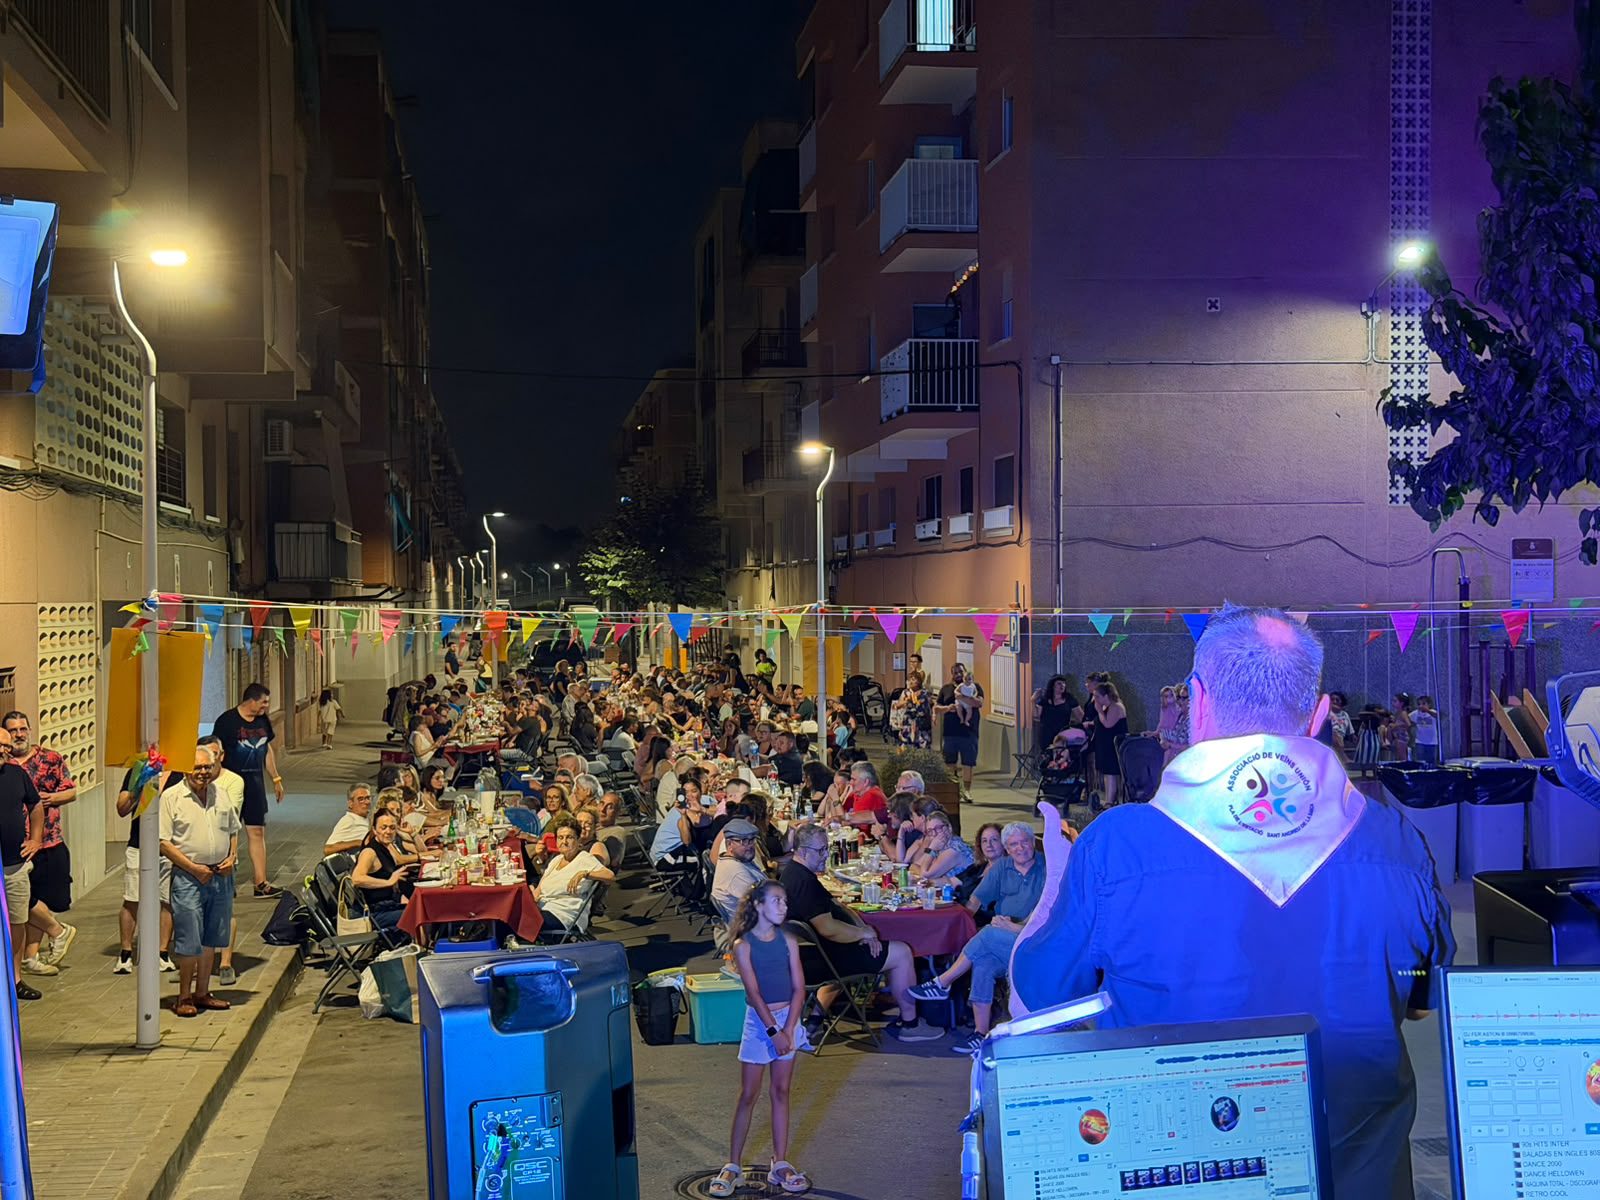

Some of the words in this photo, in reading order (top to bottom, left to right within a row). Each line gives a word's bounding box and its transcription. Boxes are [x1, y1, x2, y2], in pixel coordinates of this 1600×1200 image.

[1227, 753, 1261, 792] ASSOCIACIÓ
[1294, 767, 1312, 792] UNIÓN
[513, 1161, 548, 1171] QSC
